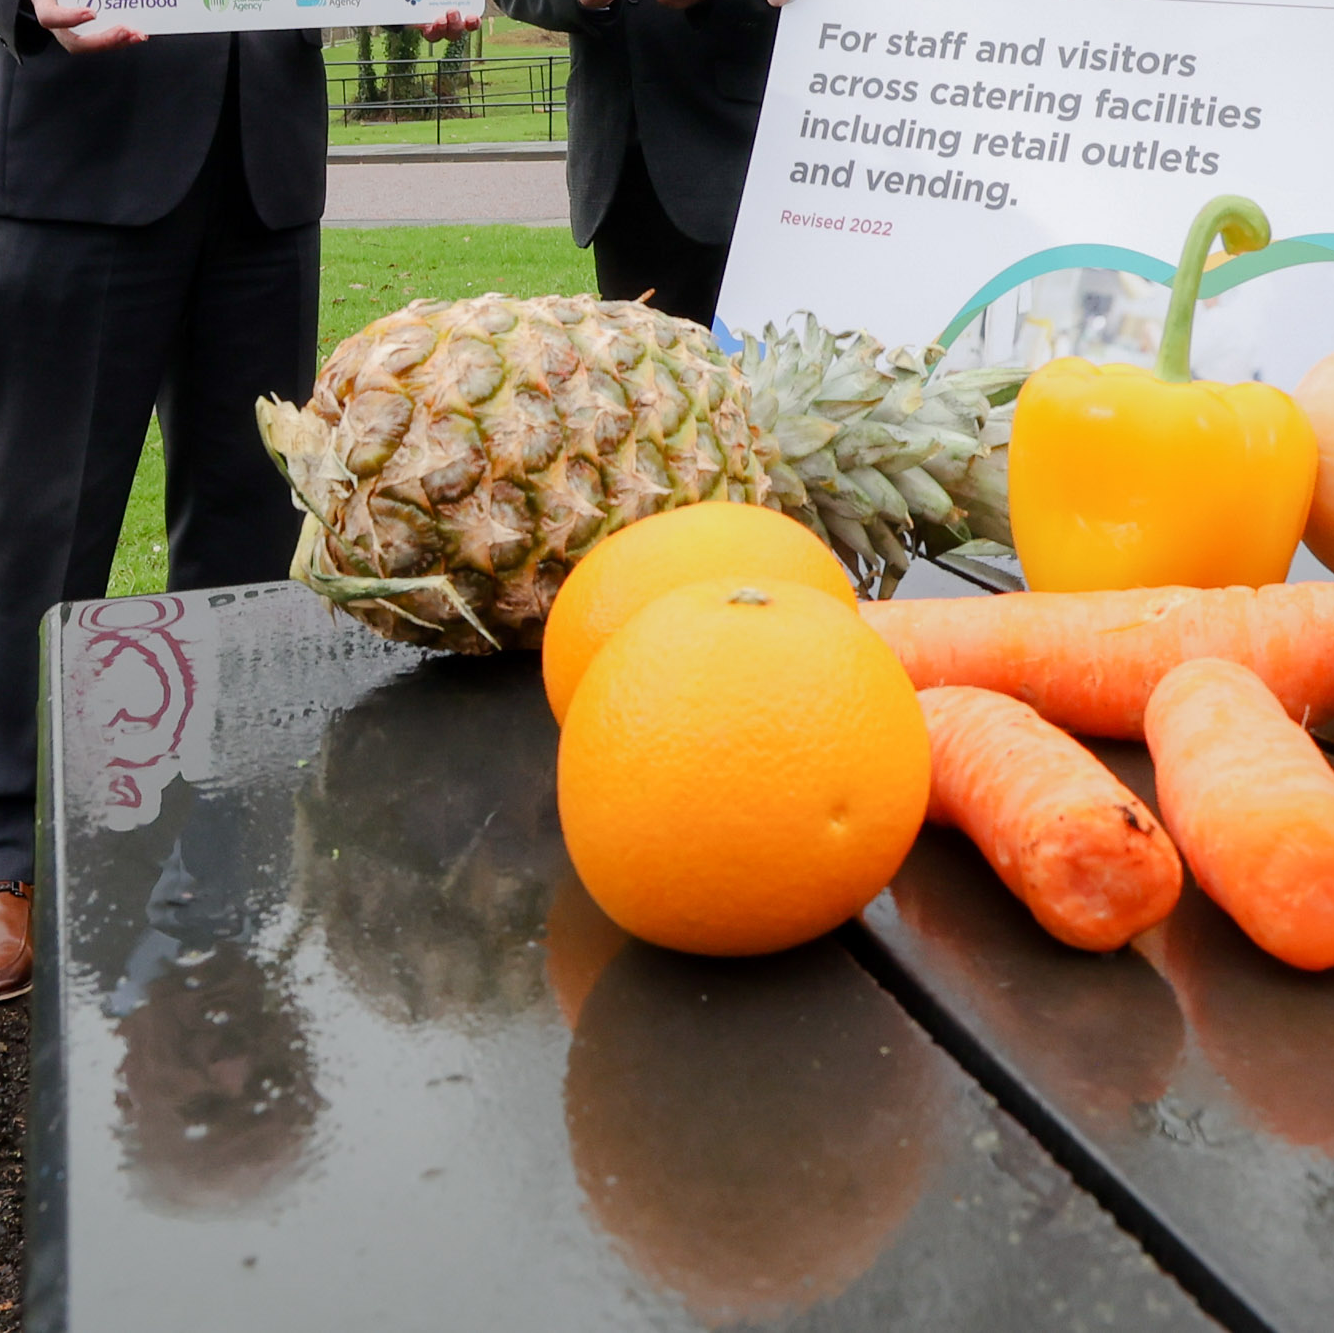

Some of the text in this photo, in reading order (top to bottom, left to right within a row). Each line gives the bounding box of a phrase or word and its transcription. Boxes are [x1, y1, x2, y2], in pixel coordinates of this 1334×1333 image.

[233, 1, 262, 11] Agency
[818, 23, 1197, 77] For staff and visitors
[809, 73, 1262, 129] across catering facilities
[800, 110, 1220, 175] including retail outlets
[789, 160, 1018, 211] and vending.
[780, 210, 893, 236] Revised 2022
